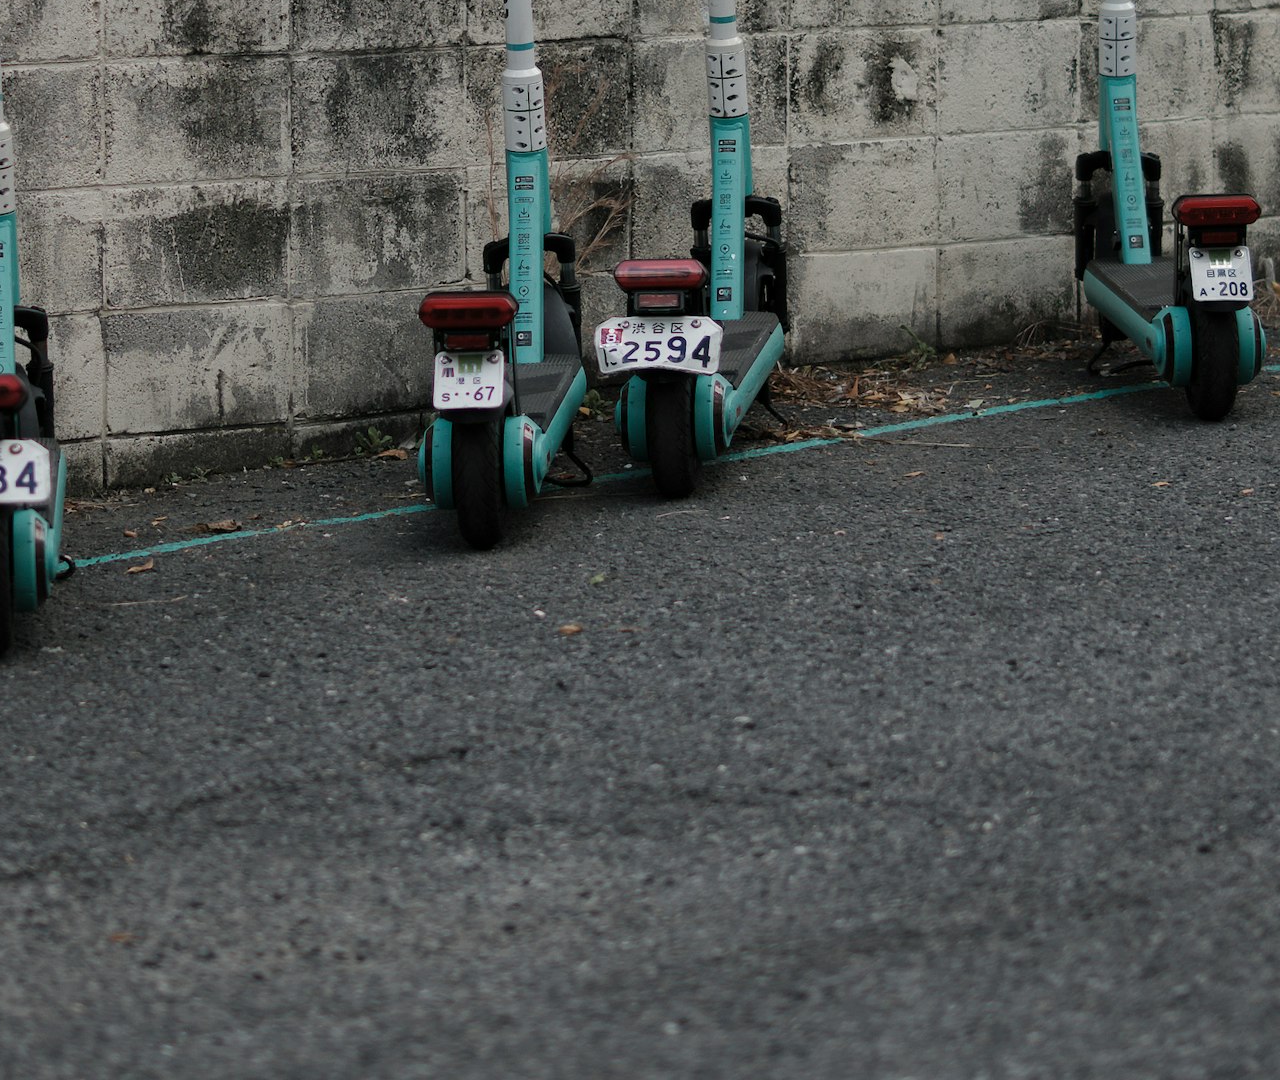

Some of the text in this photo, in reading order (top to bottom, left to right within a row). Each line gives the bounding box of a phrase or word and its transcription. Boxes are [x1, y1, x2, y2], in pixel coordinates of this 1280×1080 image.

[1206, 268, 1237, 278] 目黒区
[1200, 288, 1208, 296] A
[632, 322, 684, 334] 渋谷区
[602, 336, 712, 368] に 2594
[456, 376, 482, 384] 港区
